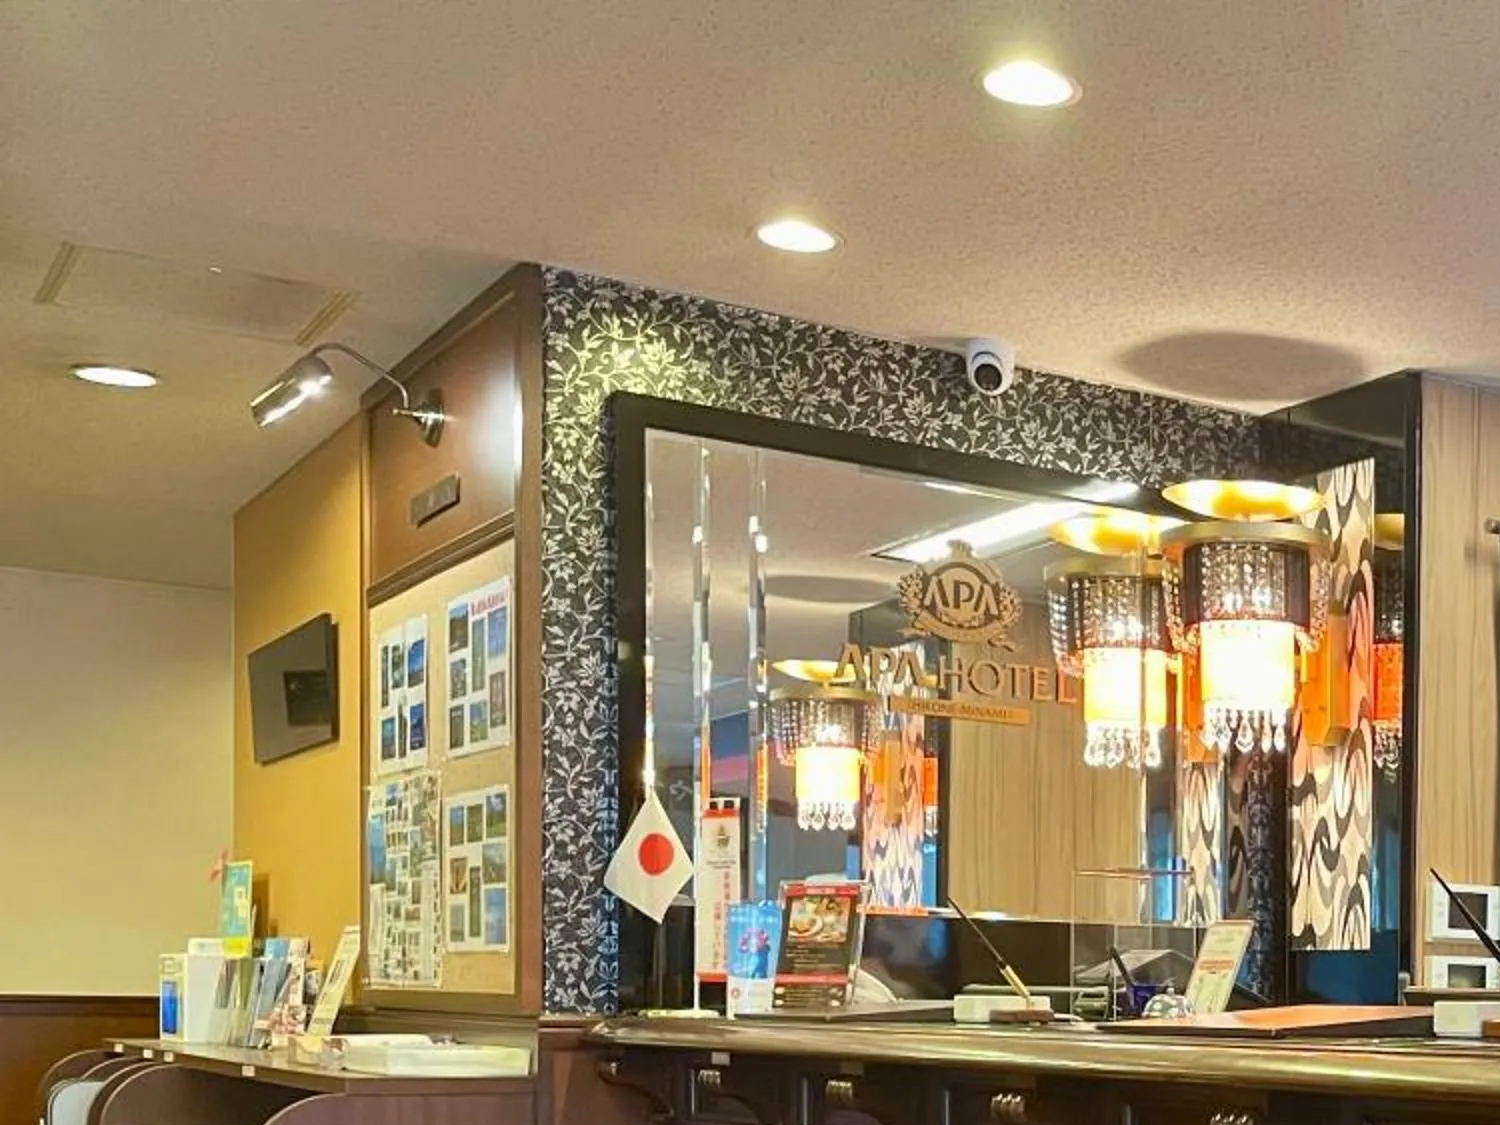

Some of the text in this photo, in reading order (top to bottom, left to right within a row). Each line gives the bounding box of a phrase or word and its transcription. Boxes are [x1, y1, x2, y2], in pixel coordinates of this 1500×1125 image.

[923, 575, 1000, 616] APA
[832, 642, 1079, 704] APA HOTEL
